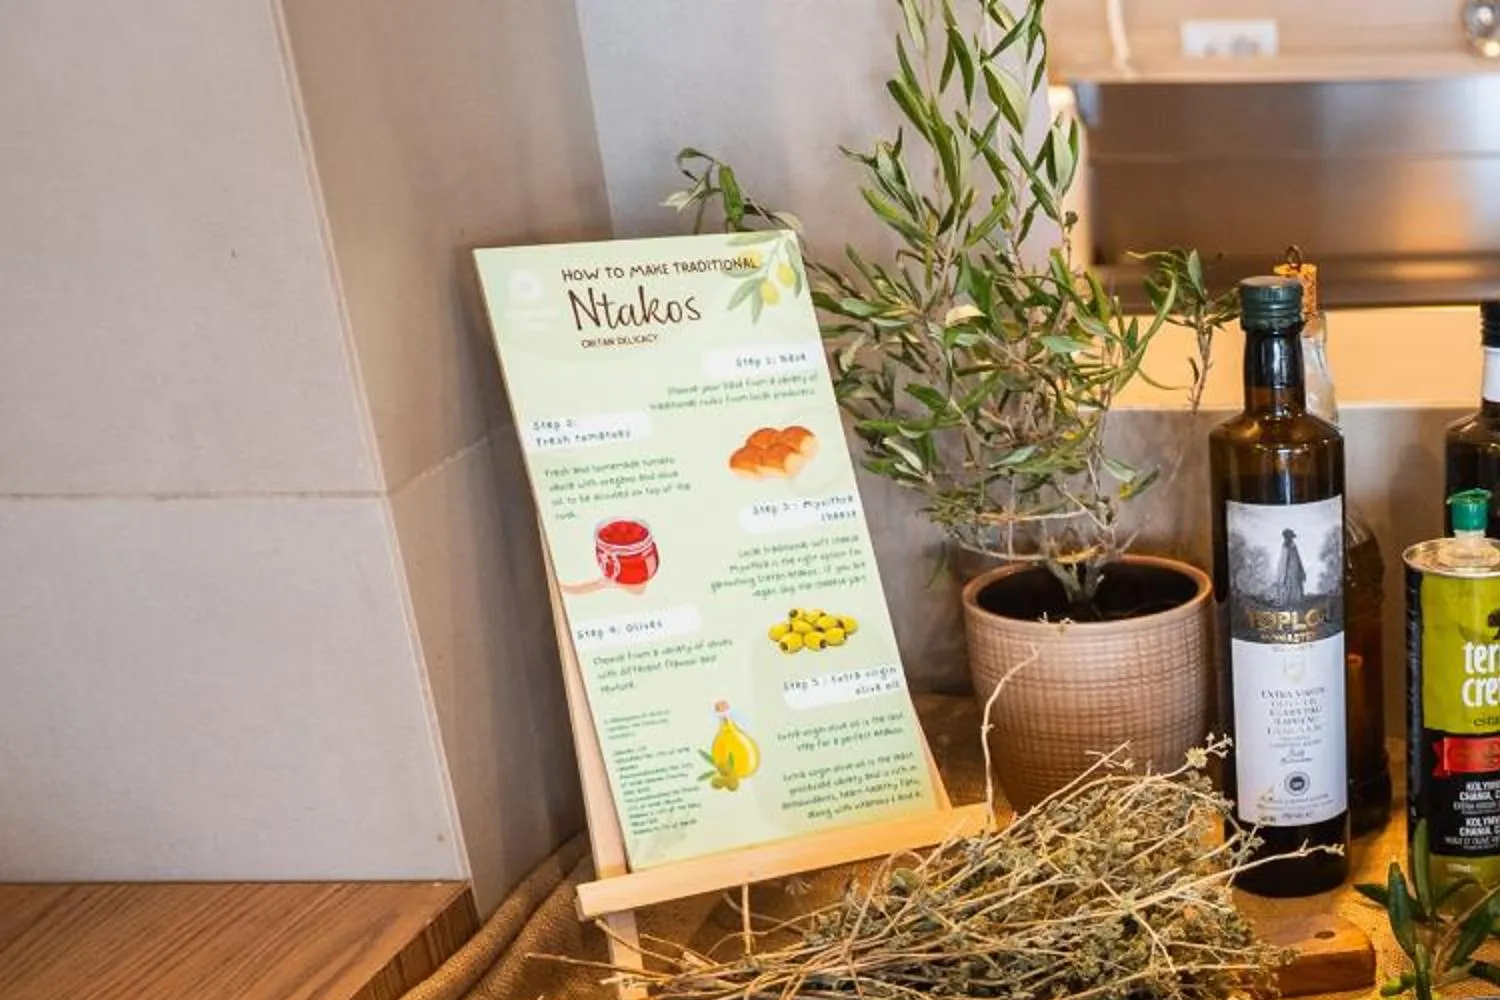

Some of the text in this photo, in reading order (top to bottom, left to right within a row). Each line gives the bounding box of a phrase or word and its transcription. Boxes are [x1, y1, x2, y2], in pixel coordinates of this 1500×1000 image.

[562, 257, 760, 283] HOW TO MAKE TRADITIONAL
[567, 285, 701, 331] Ntakos
[618, 333, 658, 345] DELICACY
